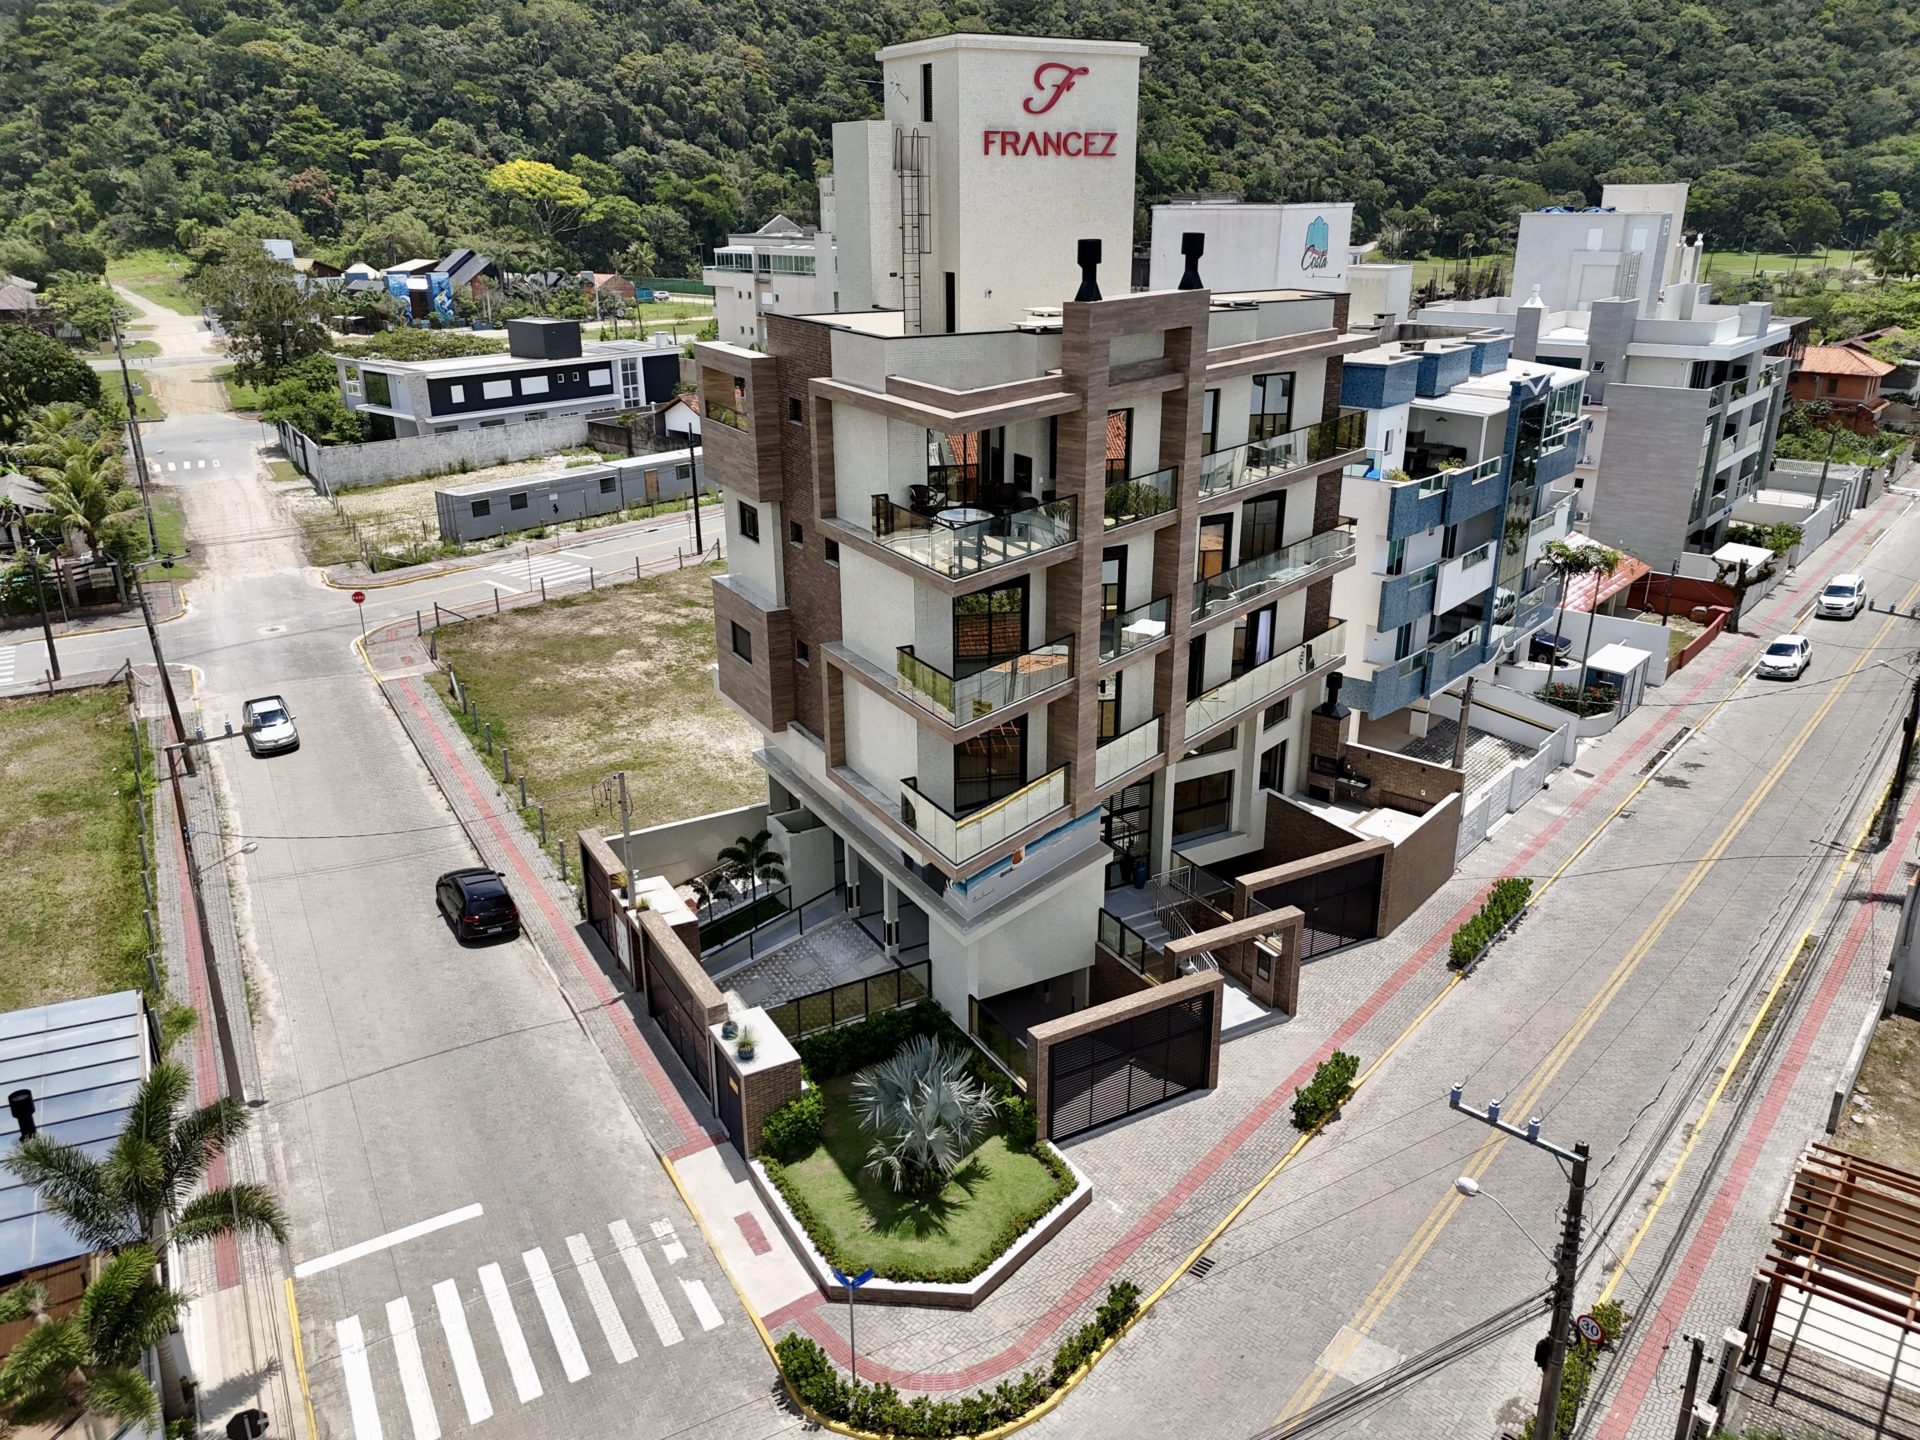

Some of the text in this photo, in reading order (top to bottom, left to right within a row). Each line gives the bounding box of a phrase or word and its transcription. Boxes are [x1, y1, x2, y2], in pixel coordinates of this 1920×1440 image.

[983, 130, 1118, 157] FRANCEZ
[1301, 244, 1328, 271] Costa
[1581, 1319, 1600, 1337] 30
